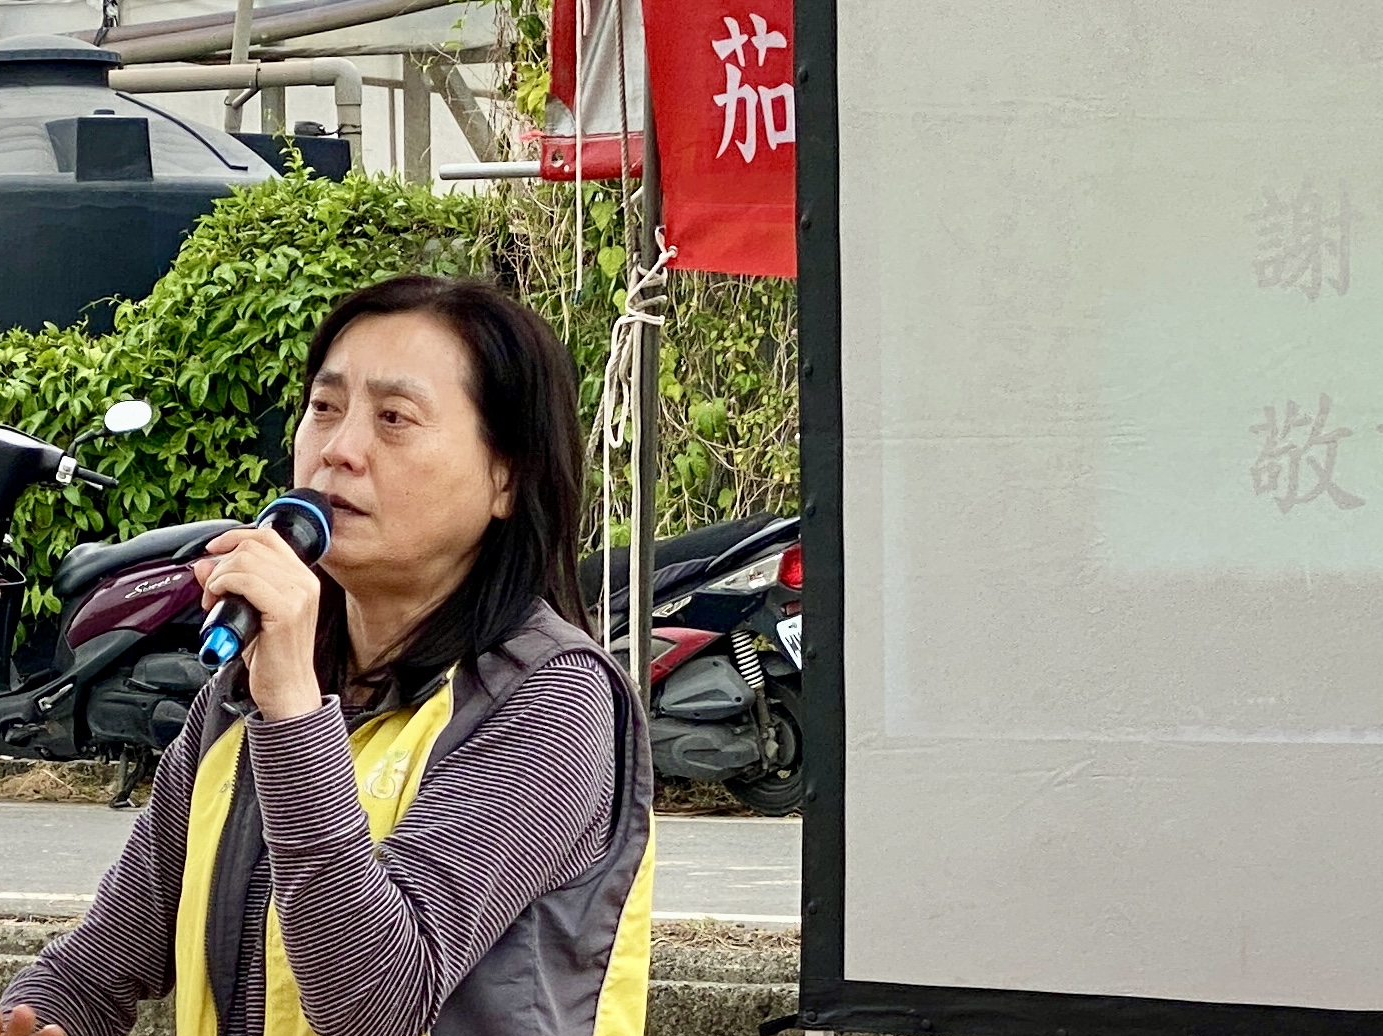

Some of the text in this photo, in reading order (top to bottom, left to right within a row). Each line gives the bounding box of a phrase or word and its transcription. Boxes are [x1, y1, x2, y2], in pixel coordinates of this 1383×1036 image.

[711, 13, 796, 163] 茄
[1245, 177, 1365, 301] 謝
[1249, 392, 1365, 514] 敬
